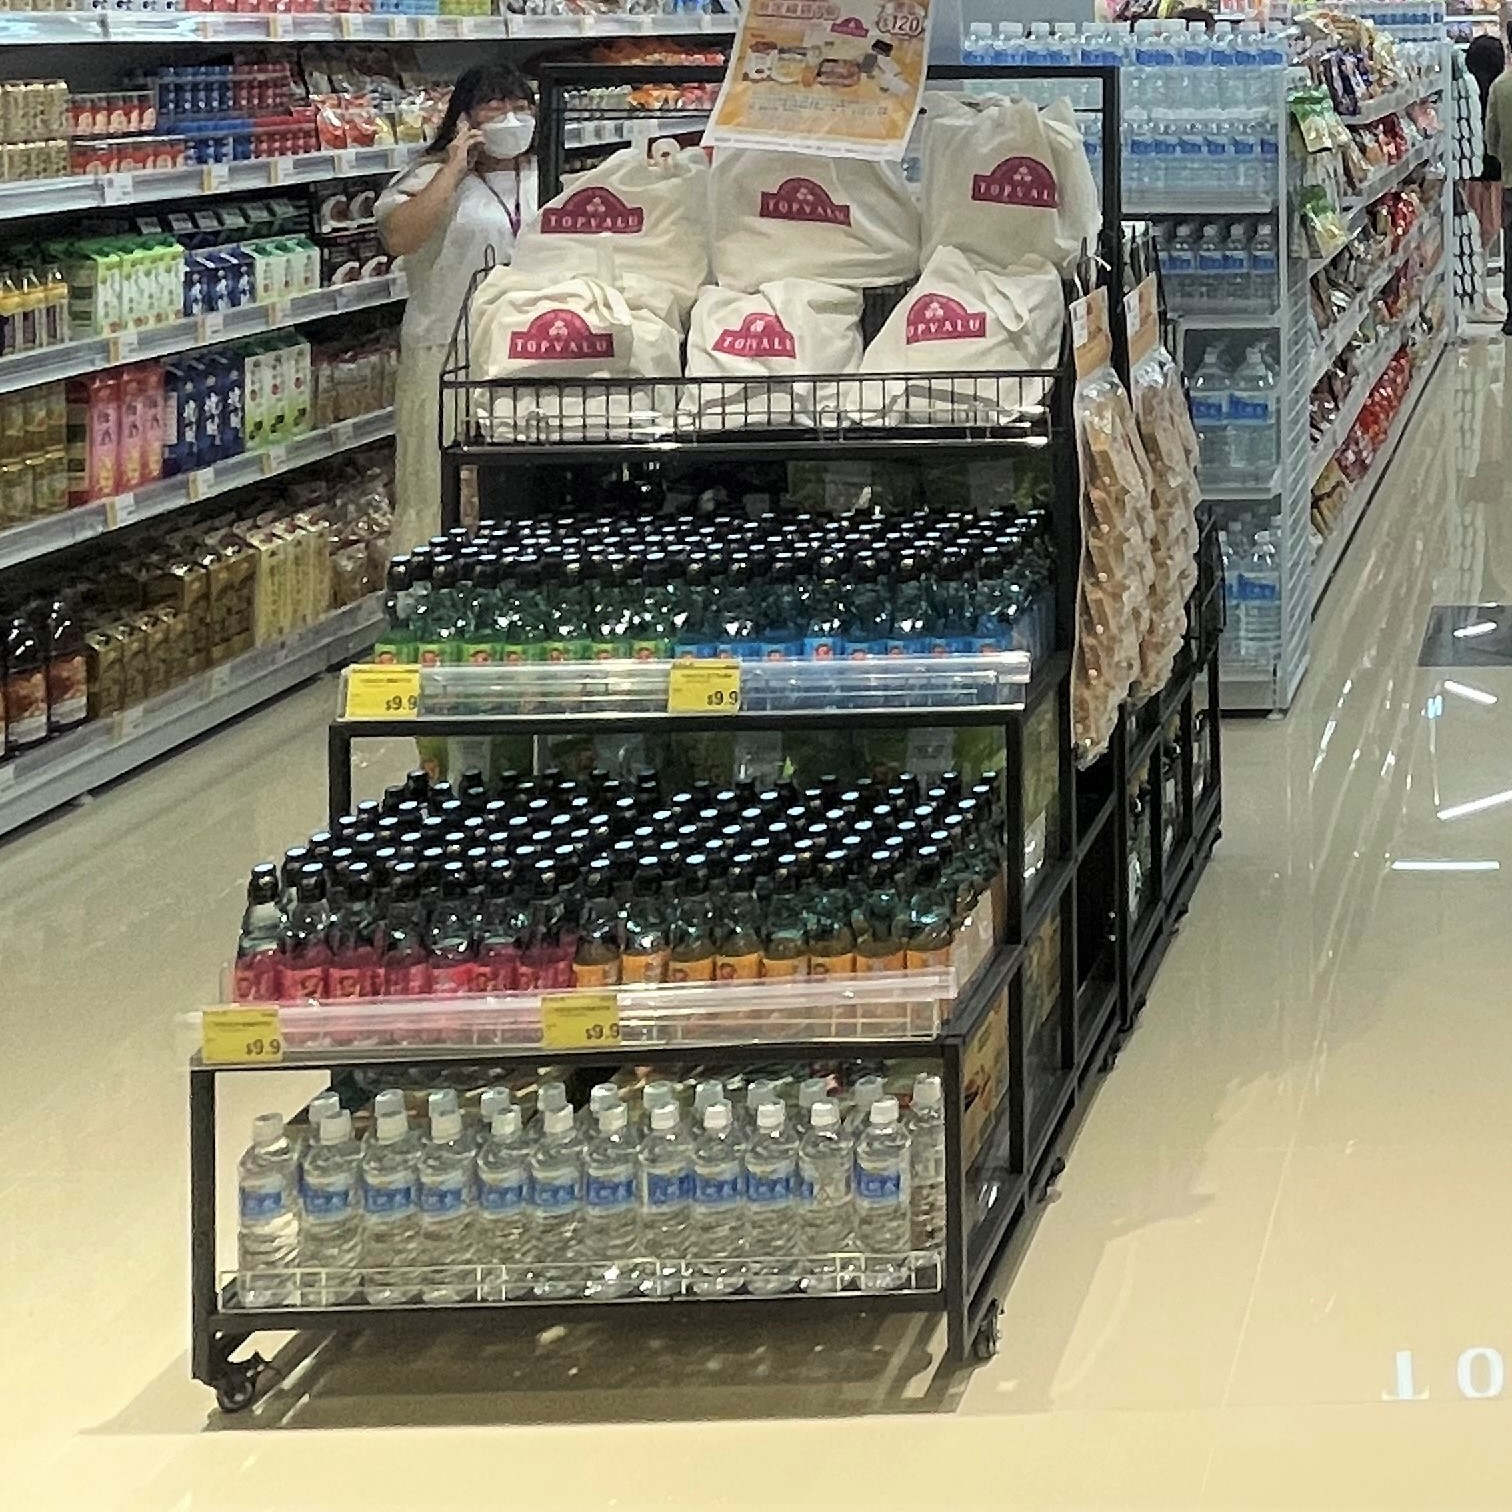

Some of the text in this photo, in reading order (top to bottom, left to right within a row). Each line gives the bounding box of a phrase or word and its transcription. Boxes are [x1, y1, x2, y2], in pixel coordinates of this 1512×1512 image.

[548, 214, 638, 229] TOPVALU
[907, 318, 981, 338] OPVALU
[514, 338, 608, 354] TOPVALU
[384, 695, 418, 712] $9.9
[245, 1038, 282, 1056] $9.9
